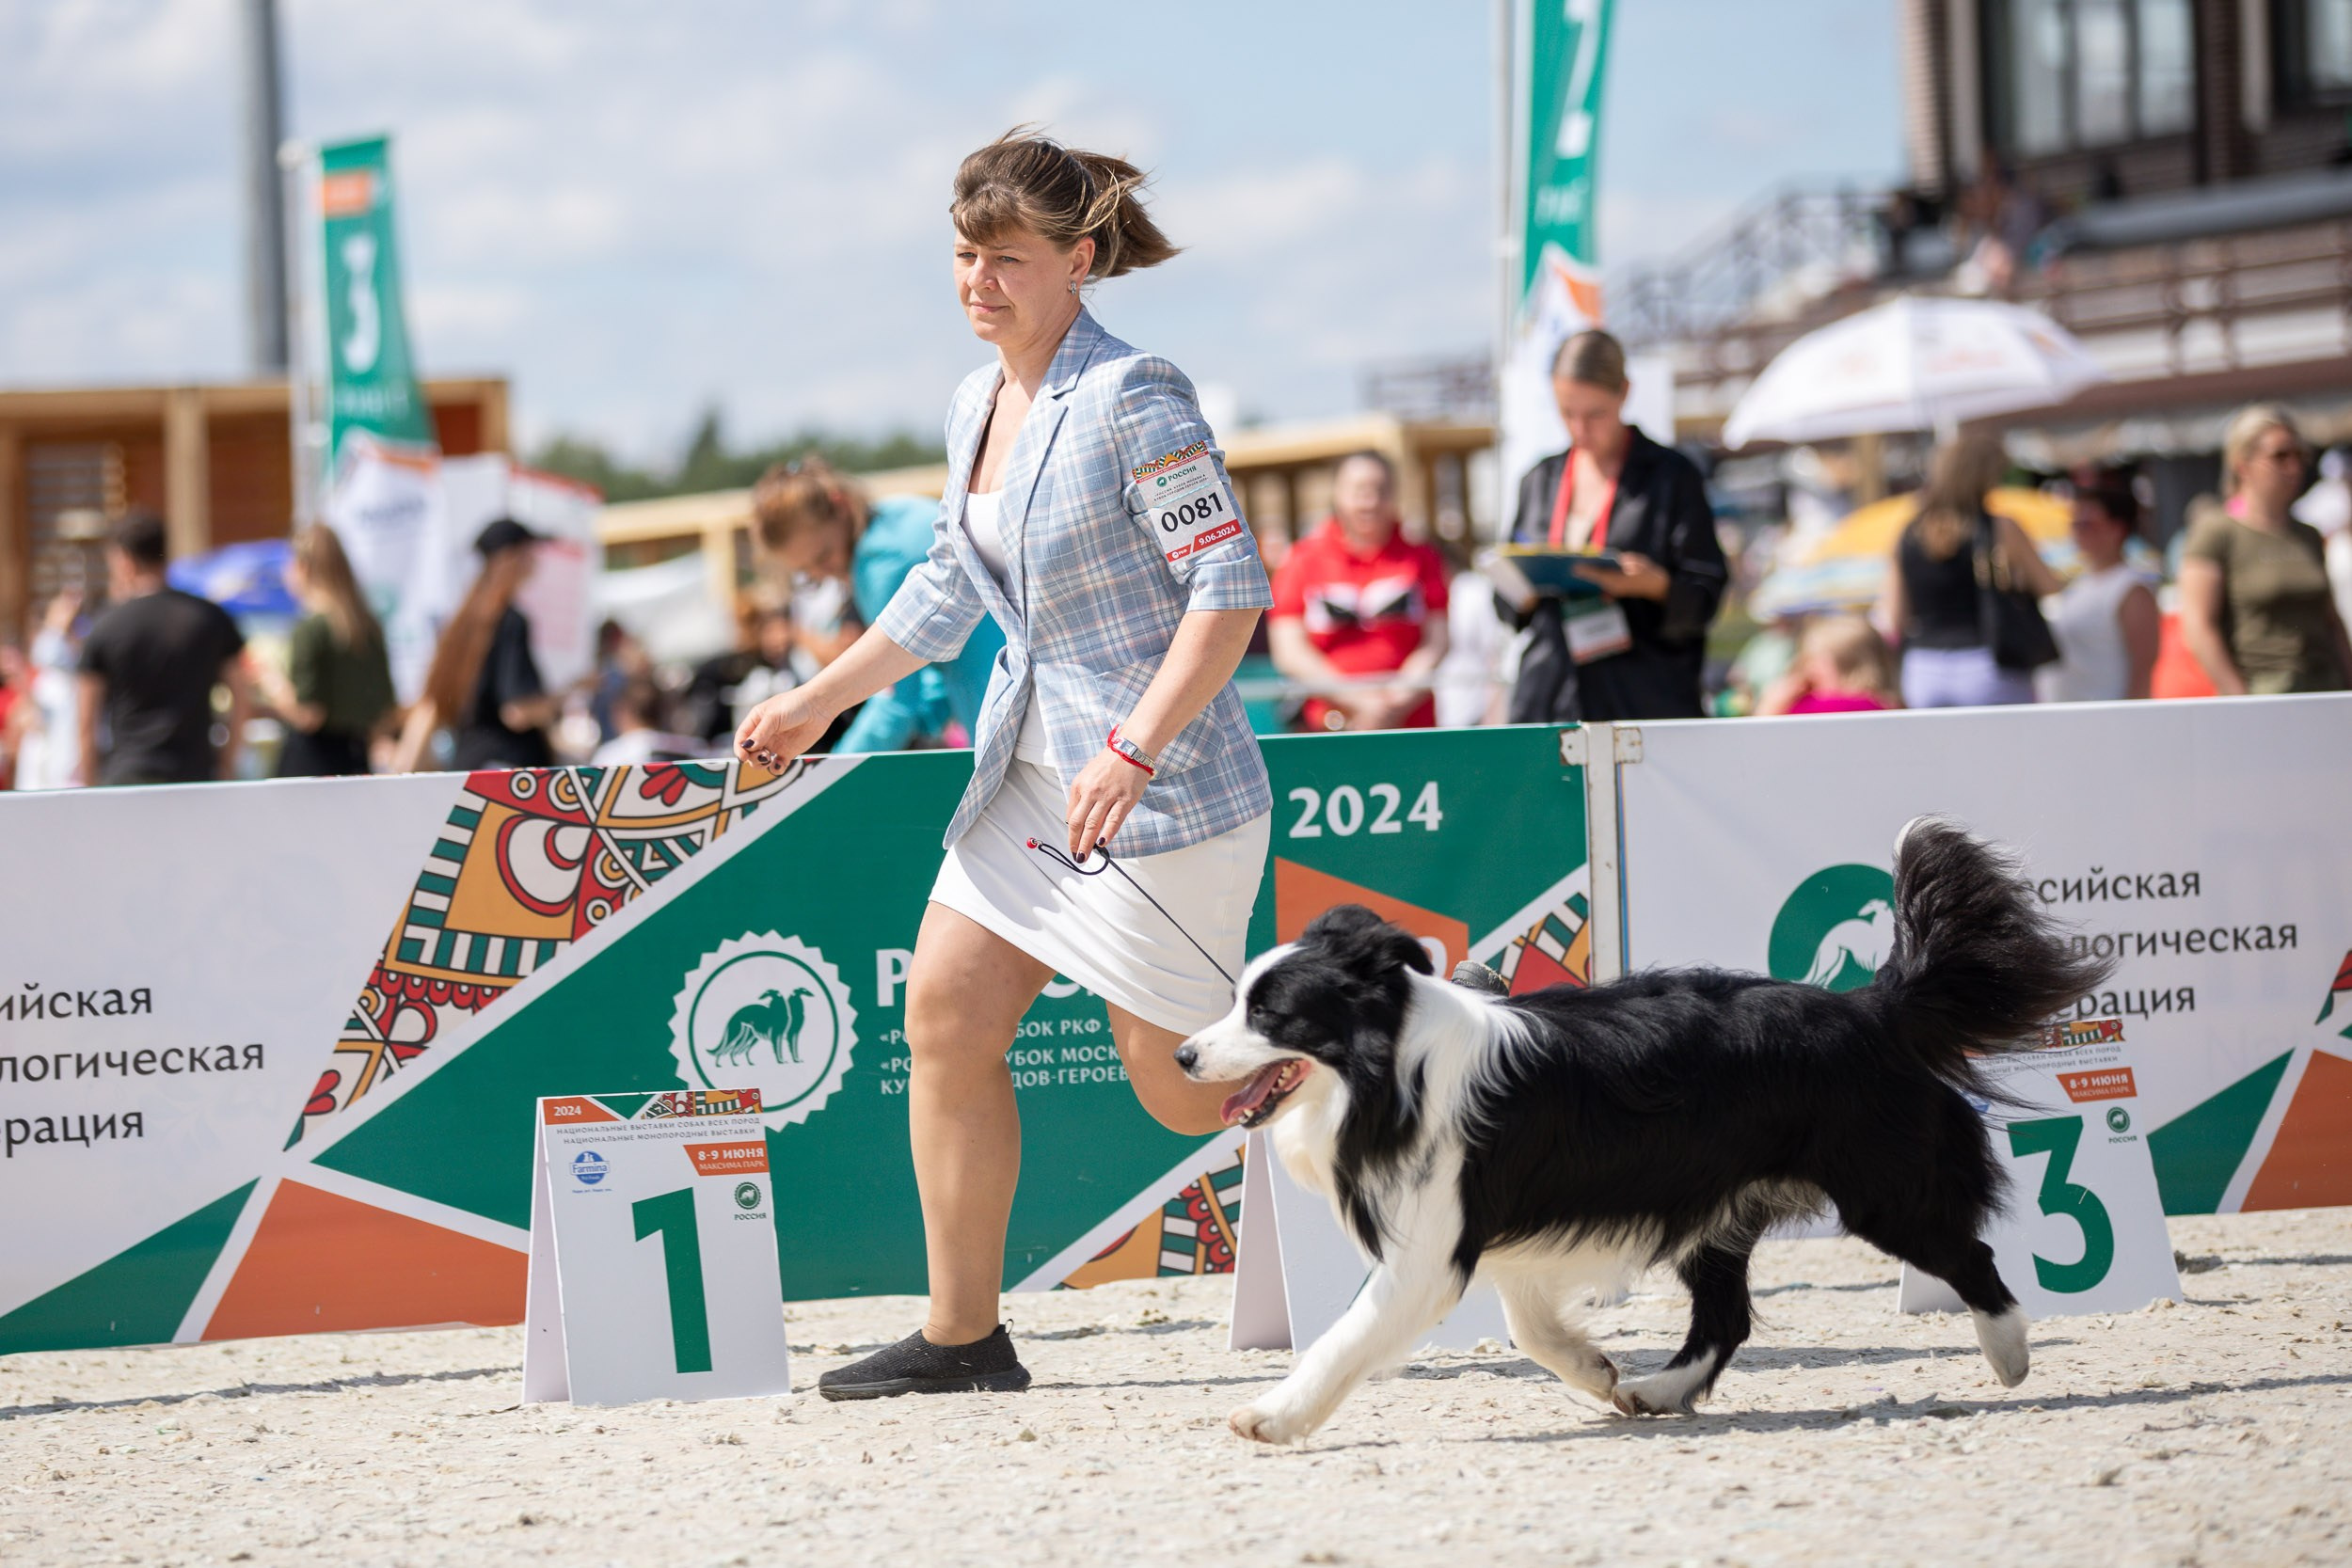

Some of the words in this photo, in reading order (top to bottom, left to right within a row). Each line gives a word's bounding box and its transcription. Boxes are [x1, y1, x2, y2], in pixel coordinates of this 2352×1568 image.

[1168, 465, 1197, 482] РОССИЯ
[1161, 491, 1223, 532] 0081
[1199, 524, 1236, 546] 9.06.2024
[1288, 781, 1443, 838] 2024
[2047, 923, 2297, 958] логическая
[1016, 1021, 1054, 1038] БОК
[1059, 1019, 1102, 1035] РКФ
[1004, 1048, 1055, 1066] УБОК
[1061, 1045, 1120, 1063] МОСК
[2095, 1046, 2122, 1054] ПОРОД
[2079, 1056, 2119, 1066] ВЫСТАВКИ
[1010, 1065, 1129, 1090] ДОВ-ГЕРОЕВ
[2070, 1078, 2088, 1089] 8-9
[2090, 1074, 2128, 1086] ИЮНЯ
[2072, 1088, 2110, 1098] МАКСИМА
[2110, 1086, 2131, 1095] ПАРК
[553, 1105, 582, 1117] 2024
[0, 1112, 144, 1158] рация
[557, 1124, 628, 1134] НАЦИОНАЛЬНЫЕ
[629, 1122, 675, 1131] ВЫСТАВКИ
[564, 1134, 634, 1145] НАЦИОНАЛЬНЫЕ
[637, 1131, 707, 1140] МОНОПОРОДНЫЕ
[711, 1128, 755, 1136] ВЫСТАВКИ
[2108, 1135, 2137, 1145] РОССИЯ
[697, 1150, 719, 1161] 8-9
[723, 1148, 765, 1159] ИЮНЯ
[572, 1164, 608, 1174] Farmina
[699, 1162, 742, 1170] МАКСИМА
[742, 1160, 766, 1168] ПАРК
[2006, 1115, 2115, 1294] 3
[734, 1212, 767, 1221] РОССИЯ
[631, 1186, 713, 1374] 1
